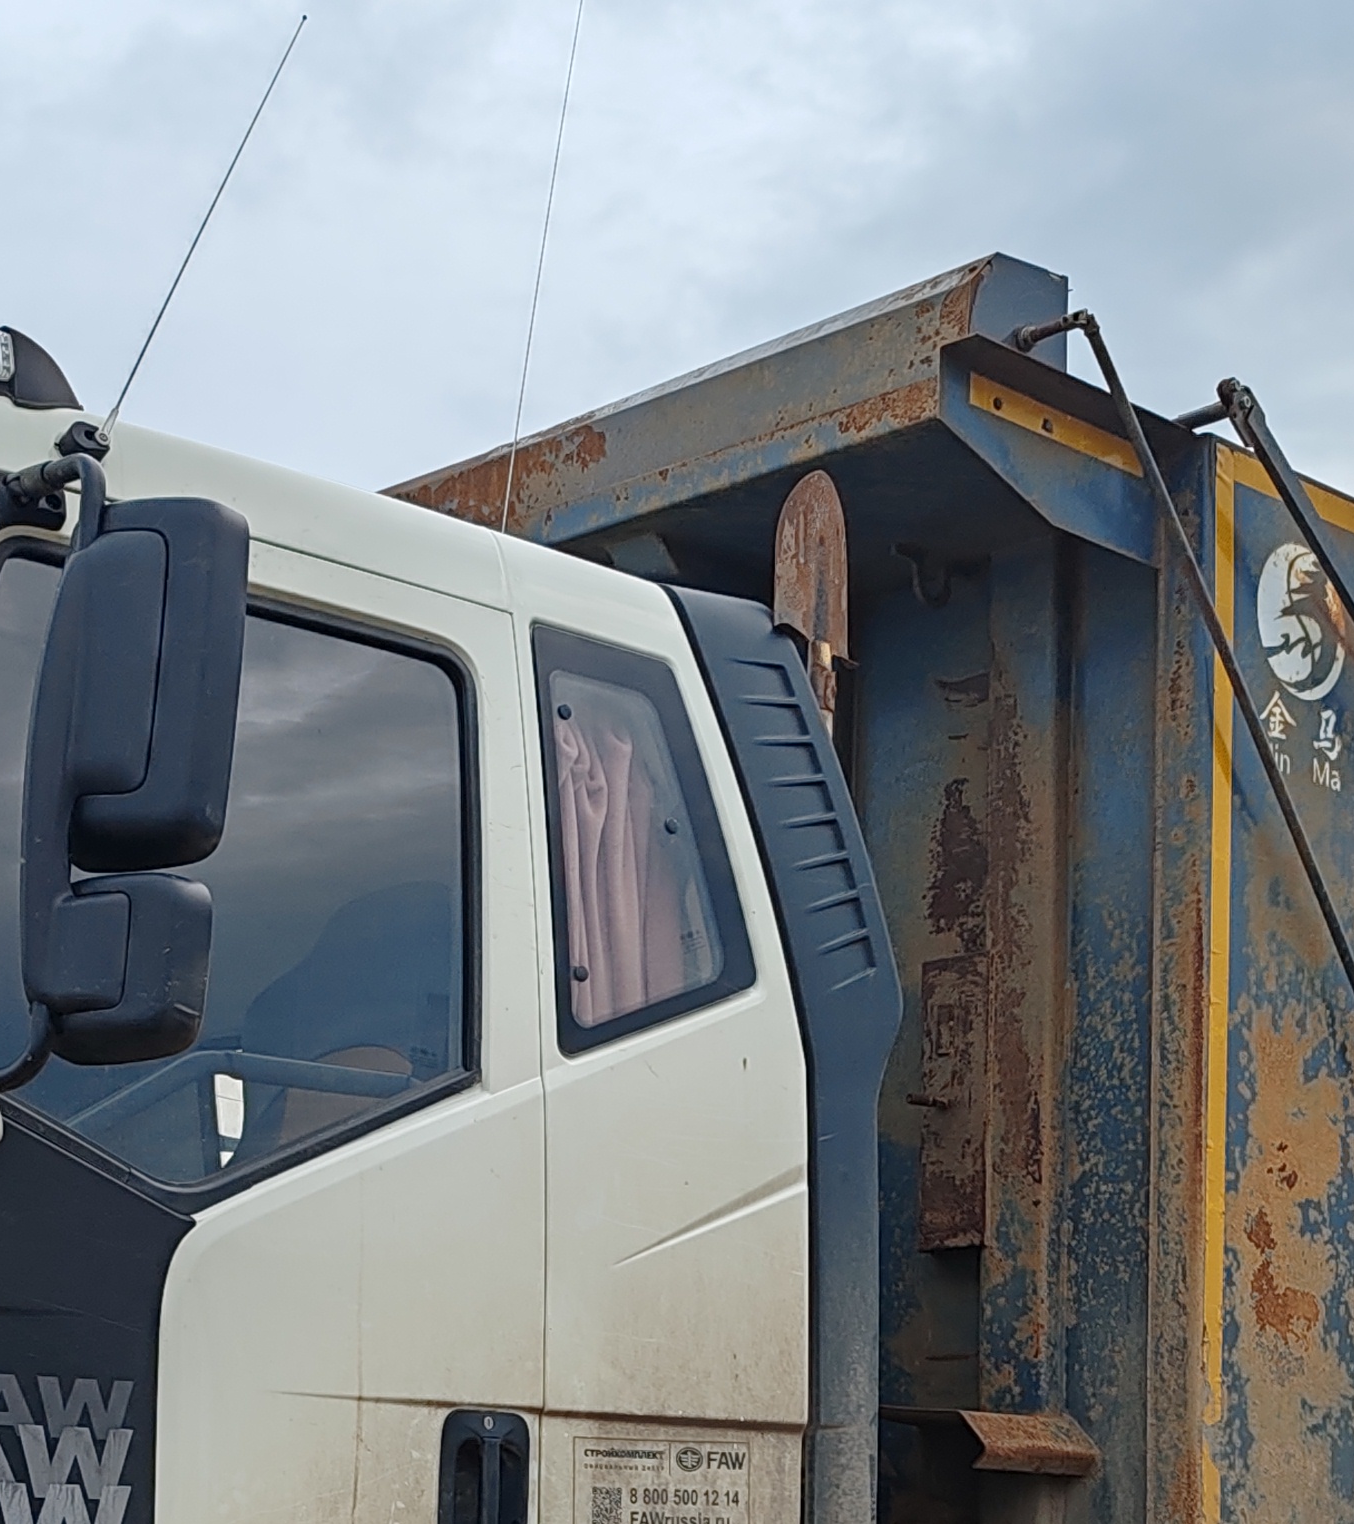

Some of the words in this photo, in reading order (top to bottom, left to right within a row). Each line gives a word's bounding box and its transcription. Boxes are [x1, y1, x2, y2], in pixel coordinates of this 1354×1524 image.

[1269, 743, 1291, 775] in
[1312, 757, 1342, 792] Ma
[583, 1447, 665, 1460] СТРОЙКОМПЛЕКТ
[706, 1451, 747, 1471] FAW
[629, 1488, 640, 1505] 8
[642, 1488, 669, 1506] 800
[673, 1489, 699, 1506] 500
[703, 1490, 720, 1506] 12
[724, 1490, 740, 1506] 14
